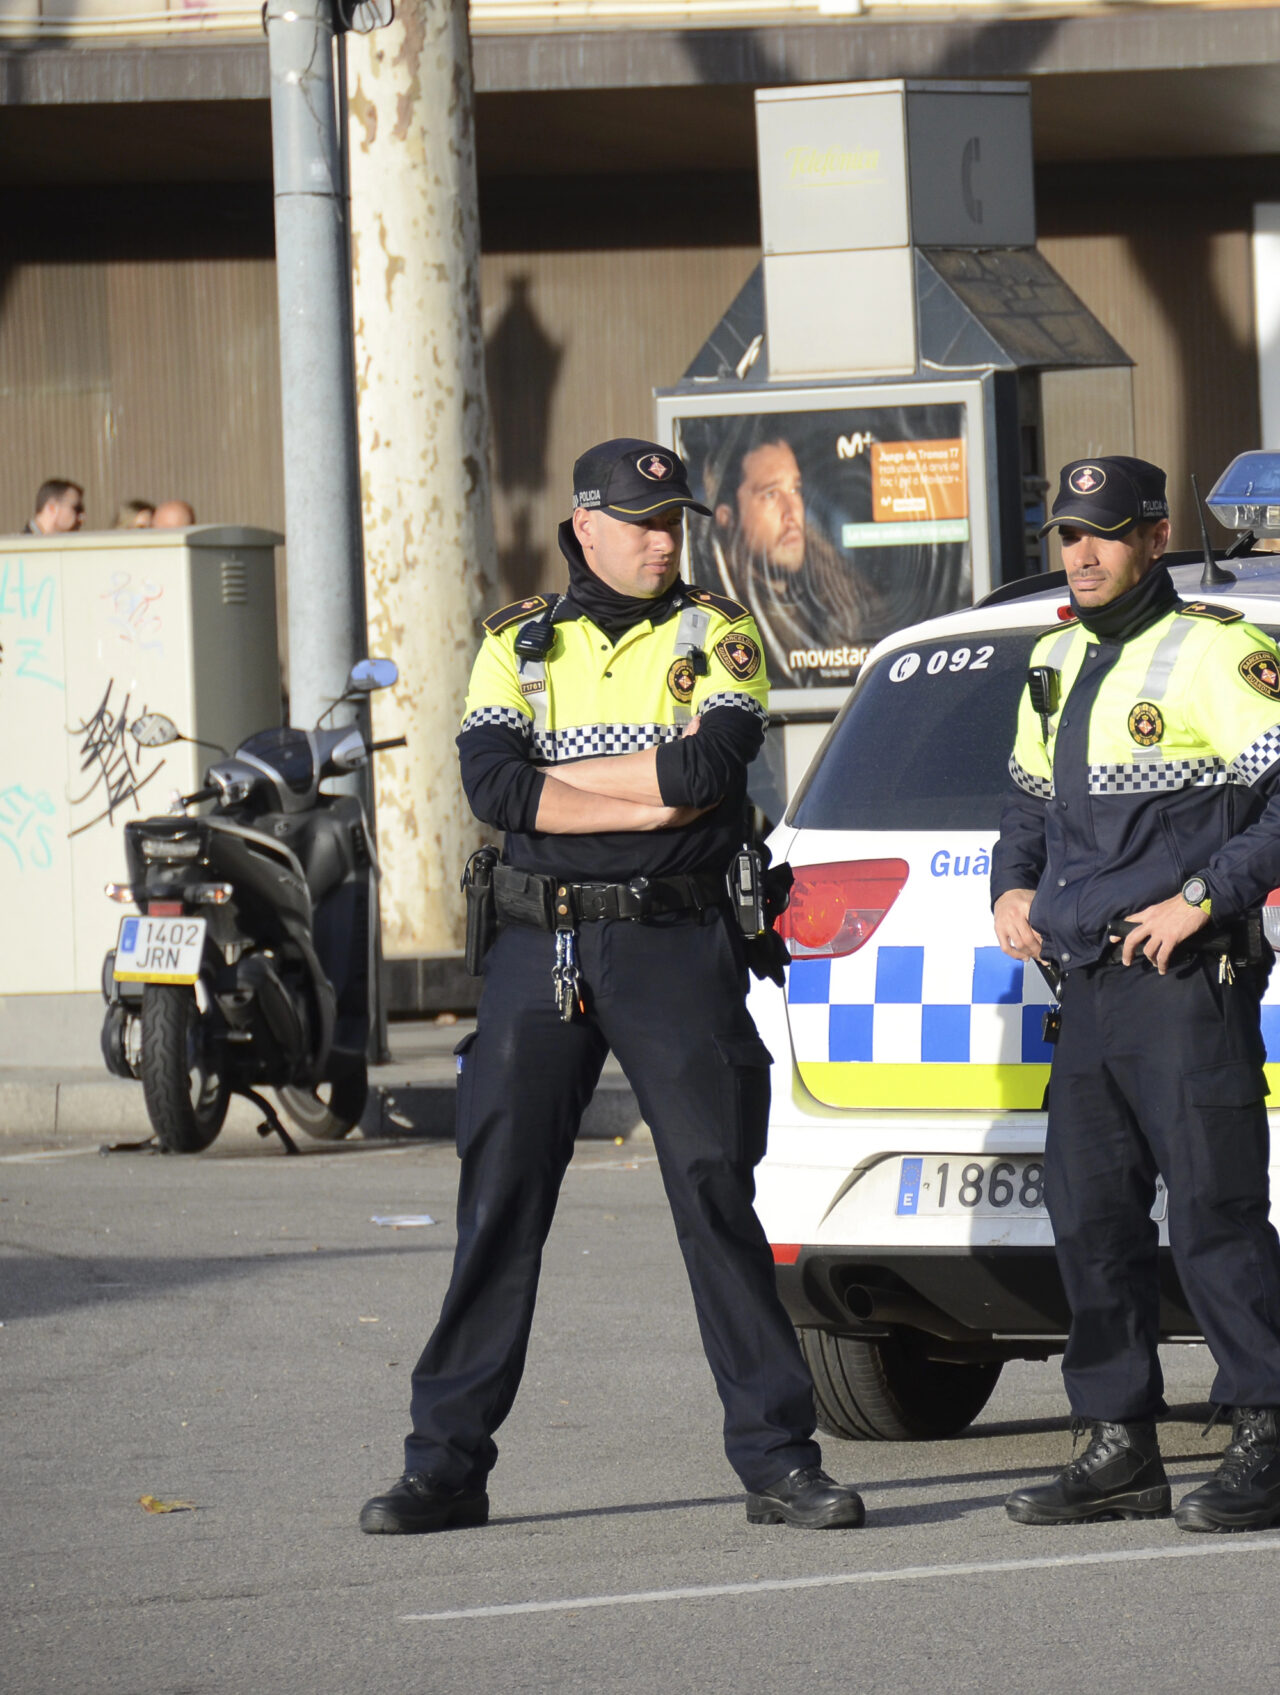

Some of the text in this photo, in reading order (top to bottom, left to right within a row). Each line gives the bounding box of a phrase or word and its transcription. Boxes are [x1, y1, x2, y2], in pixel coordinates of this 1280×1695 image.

[578, 489, 600, 502] POLICIA
[926, 645, 995, 675] 092
[146, 922, 199, 947] 1402
[135, 946, 181, 970] JRN
[937, 1162, 1046, 1208] 1868
[902, 1192, 914, 1206] E
